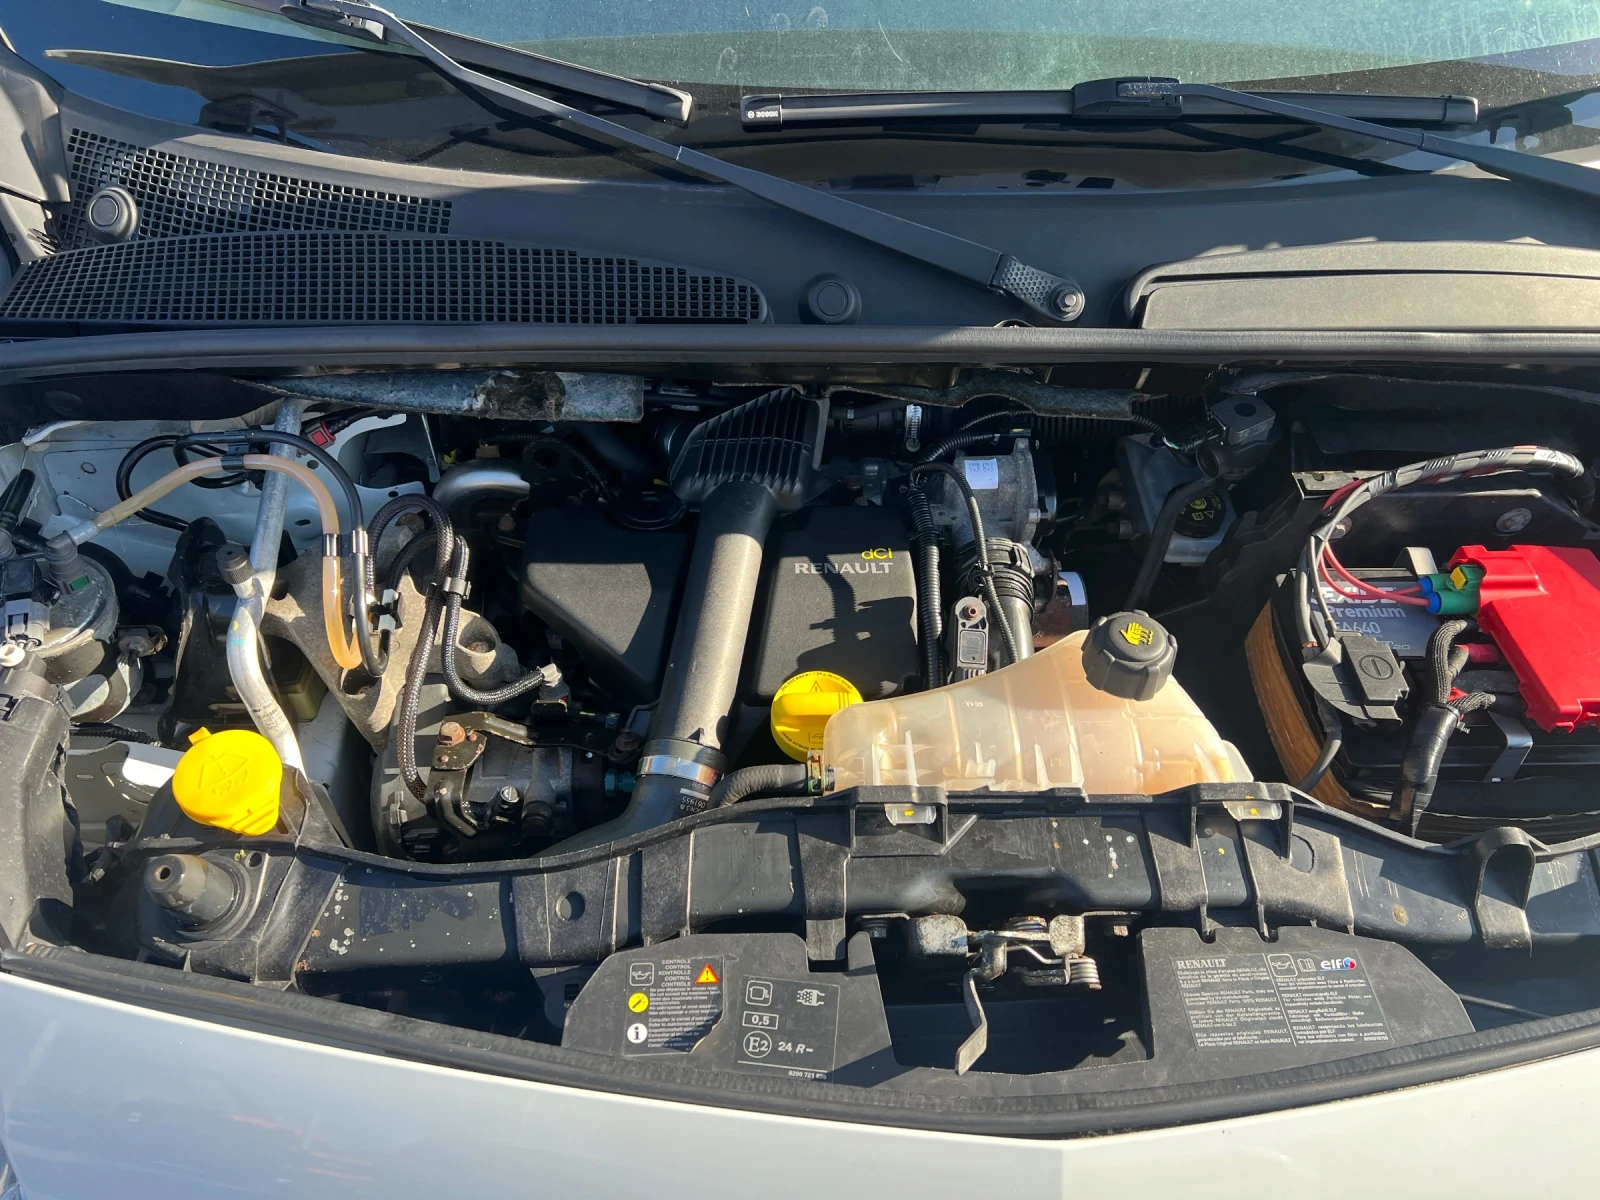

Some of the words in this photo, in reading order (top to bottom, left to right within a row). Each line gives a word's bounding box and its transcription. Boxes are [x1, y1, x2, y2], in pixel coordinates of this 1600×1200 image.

[861, 548, 893, 559] dCi
[794, 562, 893, 574] RENAULT
[1327, 605, 1406, 618] Premium
[1176, 959, 1227, 969] RENAULT
[1320, 959, 1343, 970] elf
[751, 1014, 770, 1026] 0,5
[748, 1036, 769, 1053] E2
[778, 1041, 792, 1052] 24
